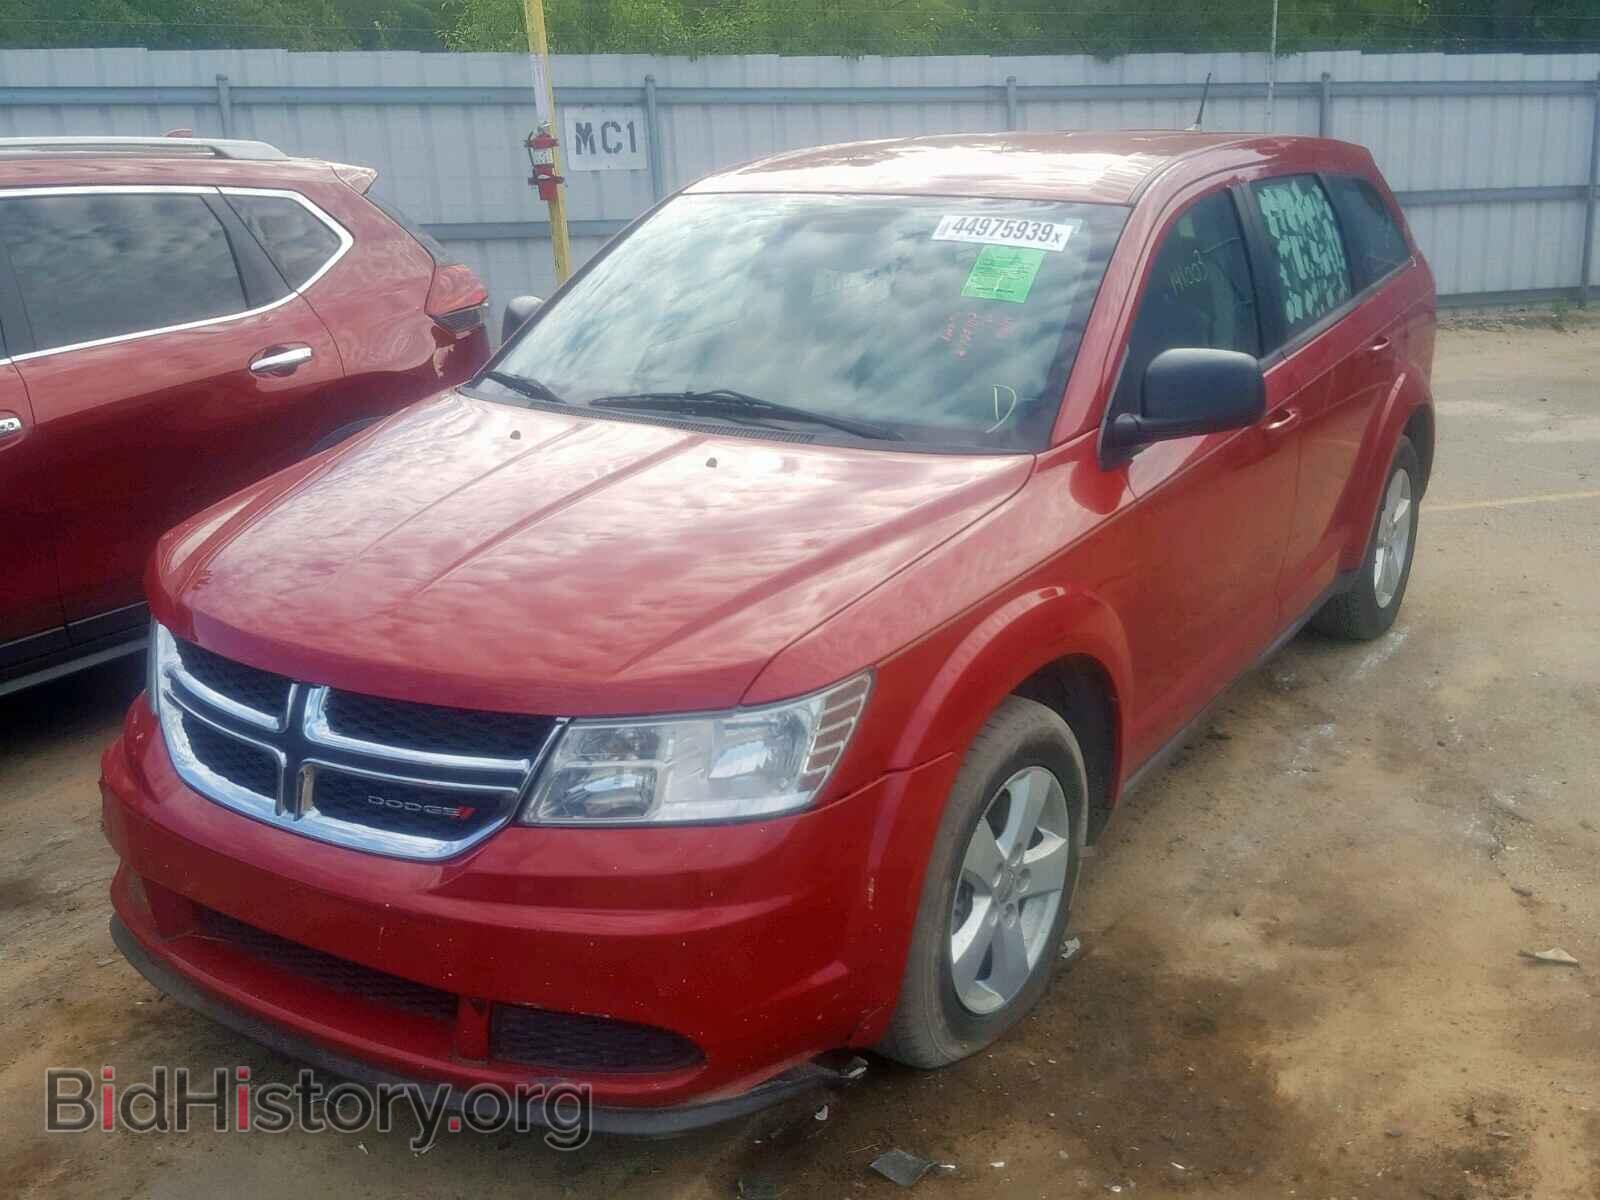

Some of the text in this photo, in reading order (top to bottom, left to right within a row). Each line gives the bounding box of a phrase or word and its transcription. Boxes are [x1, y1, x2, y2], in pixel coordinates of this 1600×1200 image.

[575, 120, 637, 155] MC1
[985, 384, 1017, 434] D
[368, 795, 461, 816] DODGE
